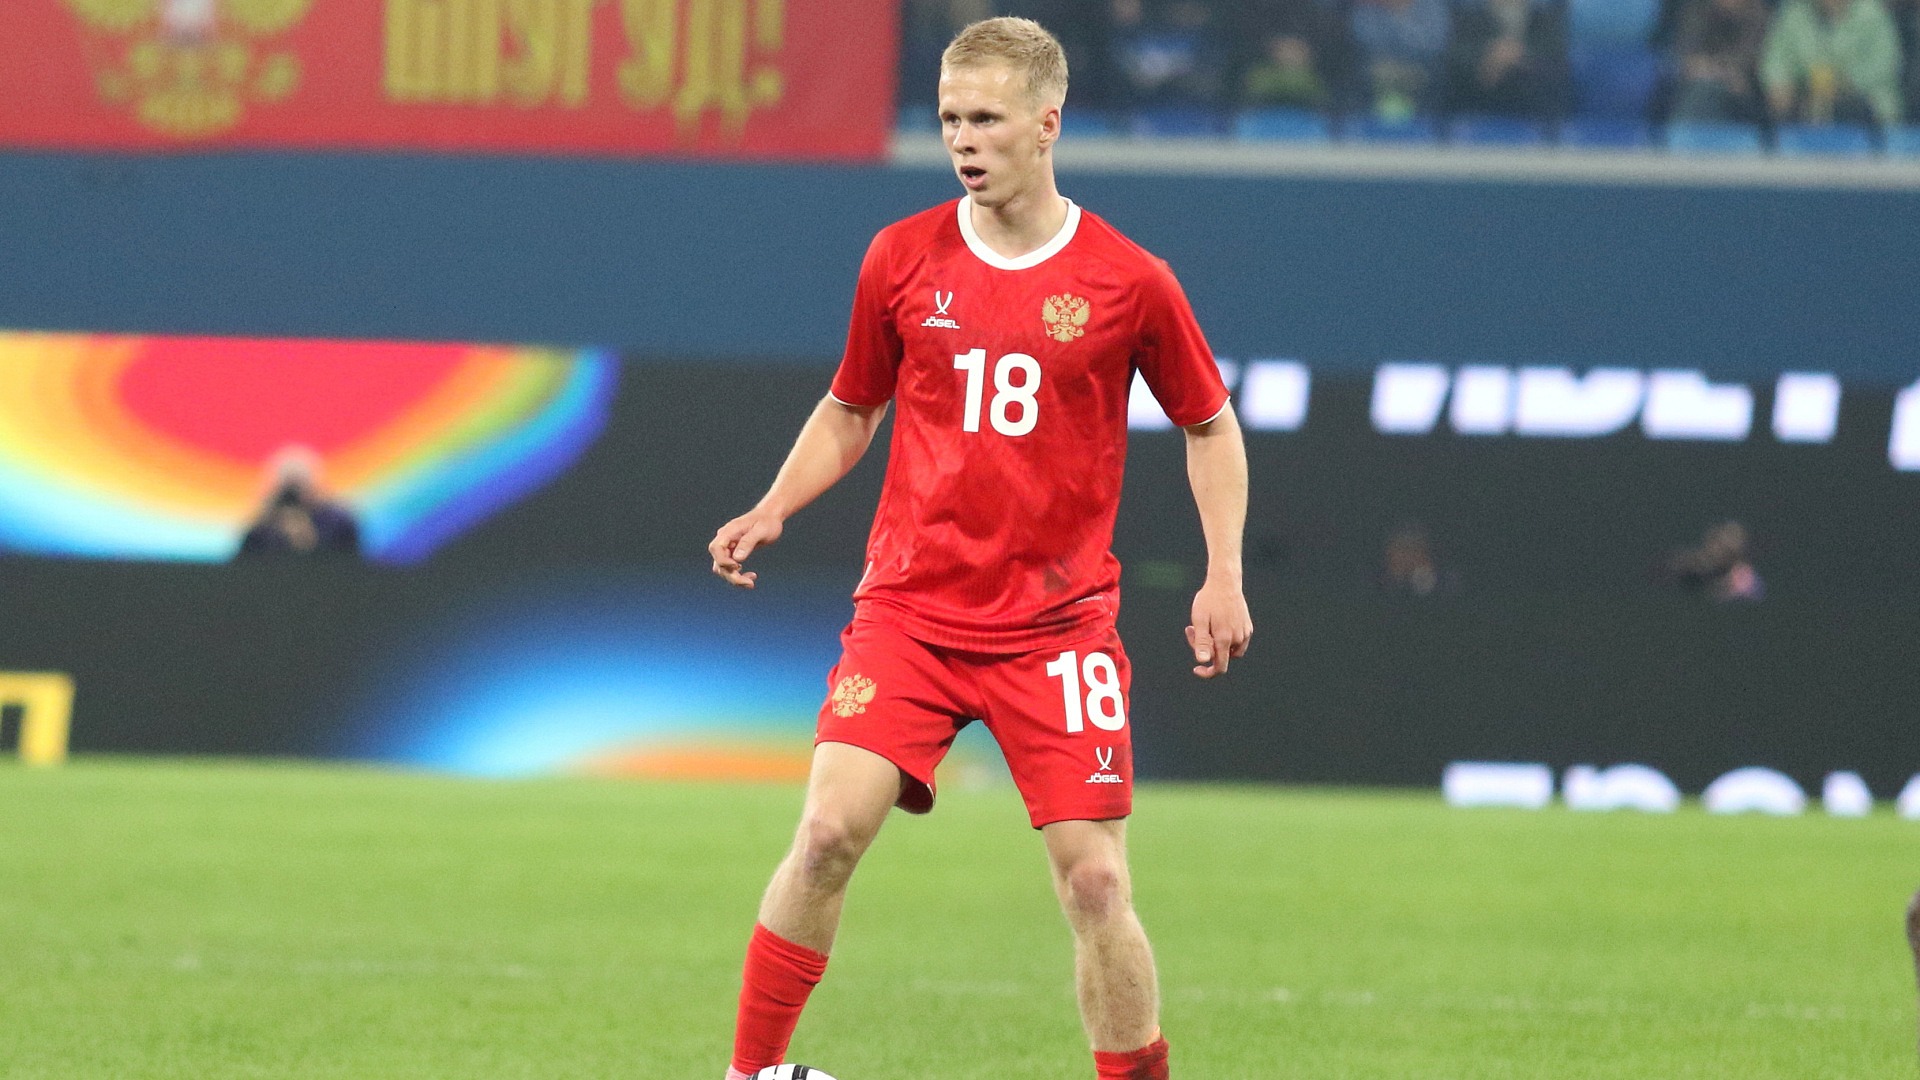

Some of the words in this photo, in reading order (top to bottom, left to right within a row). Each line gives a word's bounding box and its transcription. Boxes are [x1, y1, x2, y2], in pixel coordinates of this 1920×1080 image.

[920, 317, 960, 329] JÖGEL
[953, 348, 1042, 437] 18
[1046, 650, 1126, 733] 18
[1085, 773, 1123, 783] JÖGEL
